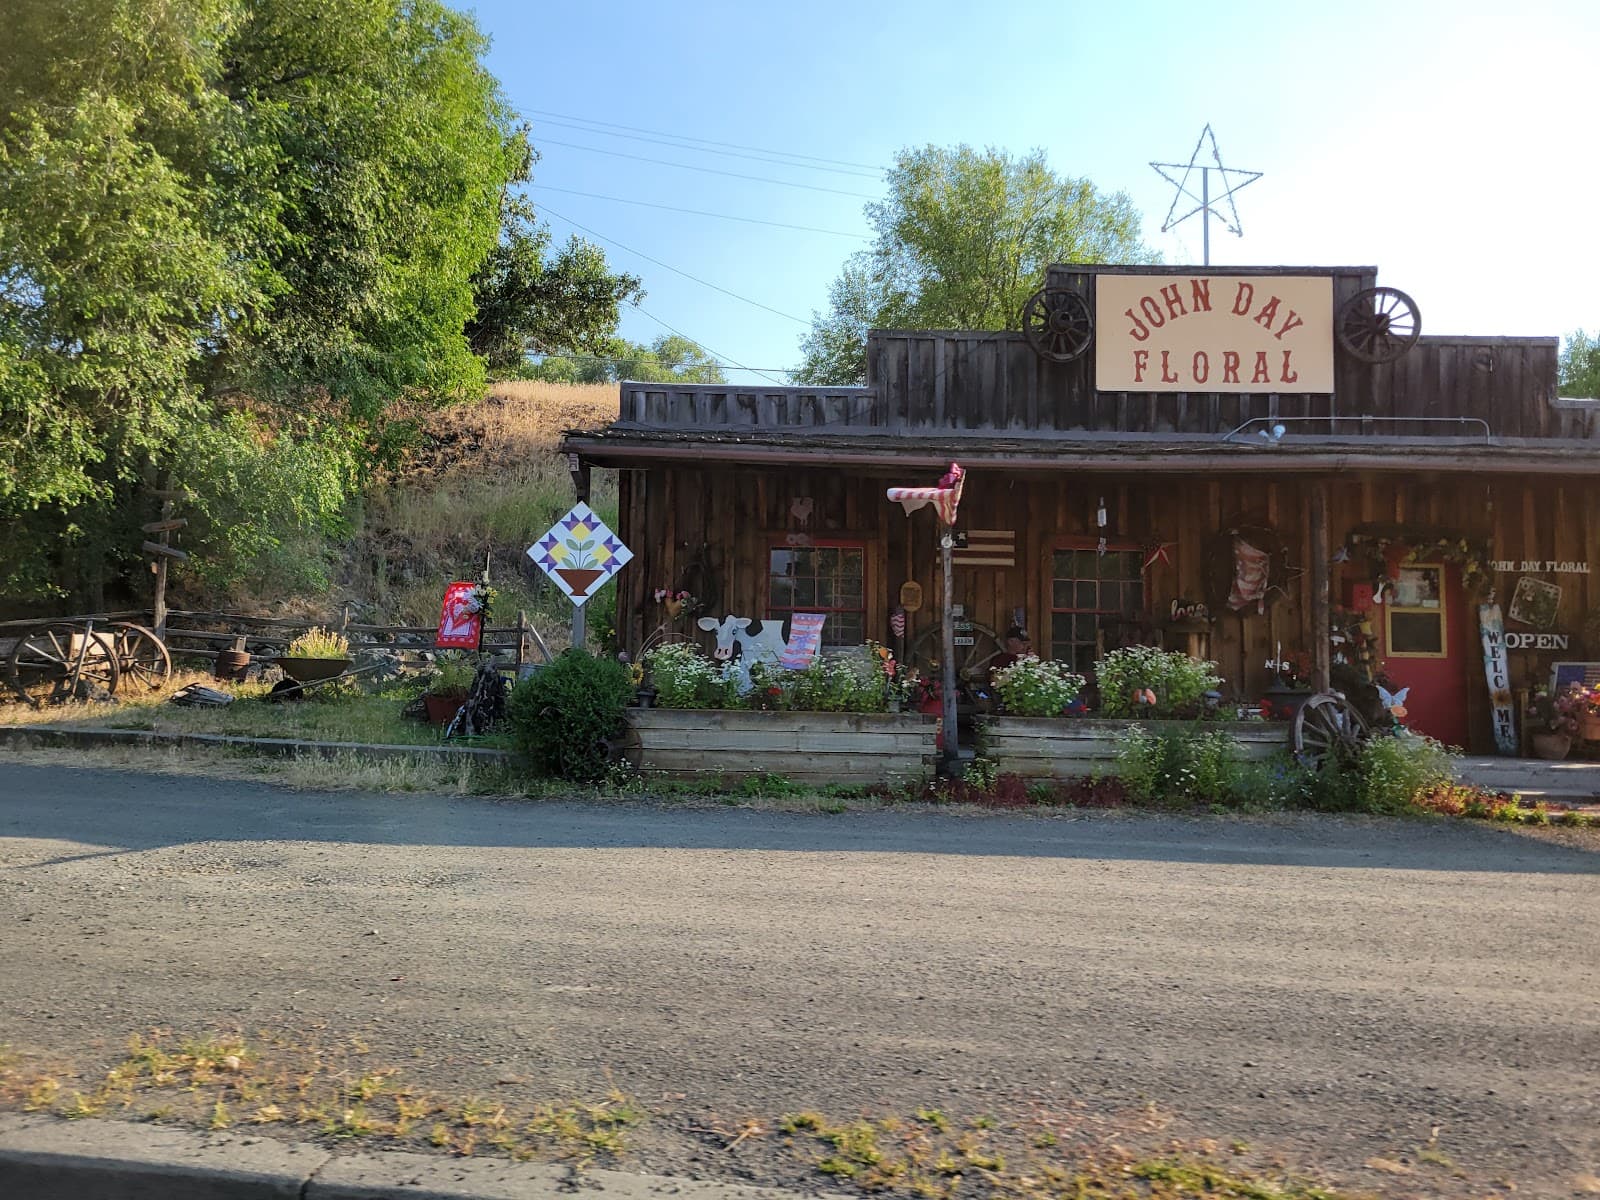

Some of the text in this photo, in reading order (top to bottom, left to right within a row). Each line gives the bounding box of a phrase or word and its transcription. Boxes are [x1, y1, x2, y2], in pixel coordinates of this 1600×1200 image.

[1124, 279, 1303, 341] JOHN DAY
[1133, 350, 1298, 384] FLORAL
[1488, 561, 1591, 573] OHN DAY FLORAL
[1504, 632, 1569, 650] OPEN
[1264, 659, 1290, 671] N S
[1488, 631, 1511, 738] WELCME
